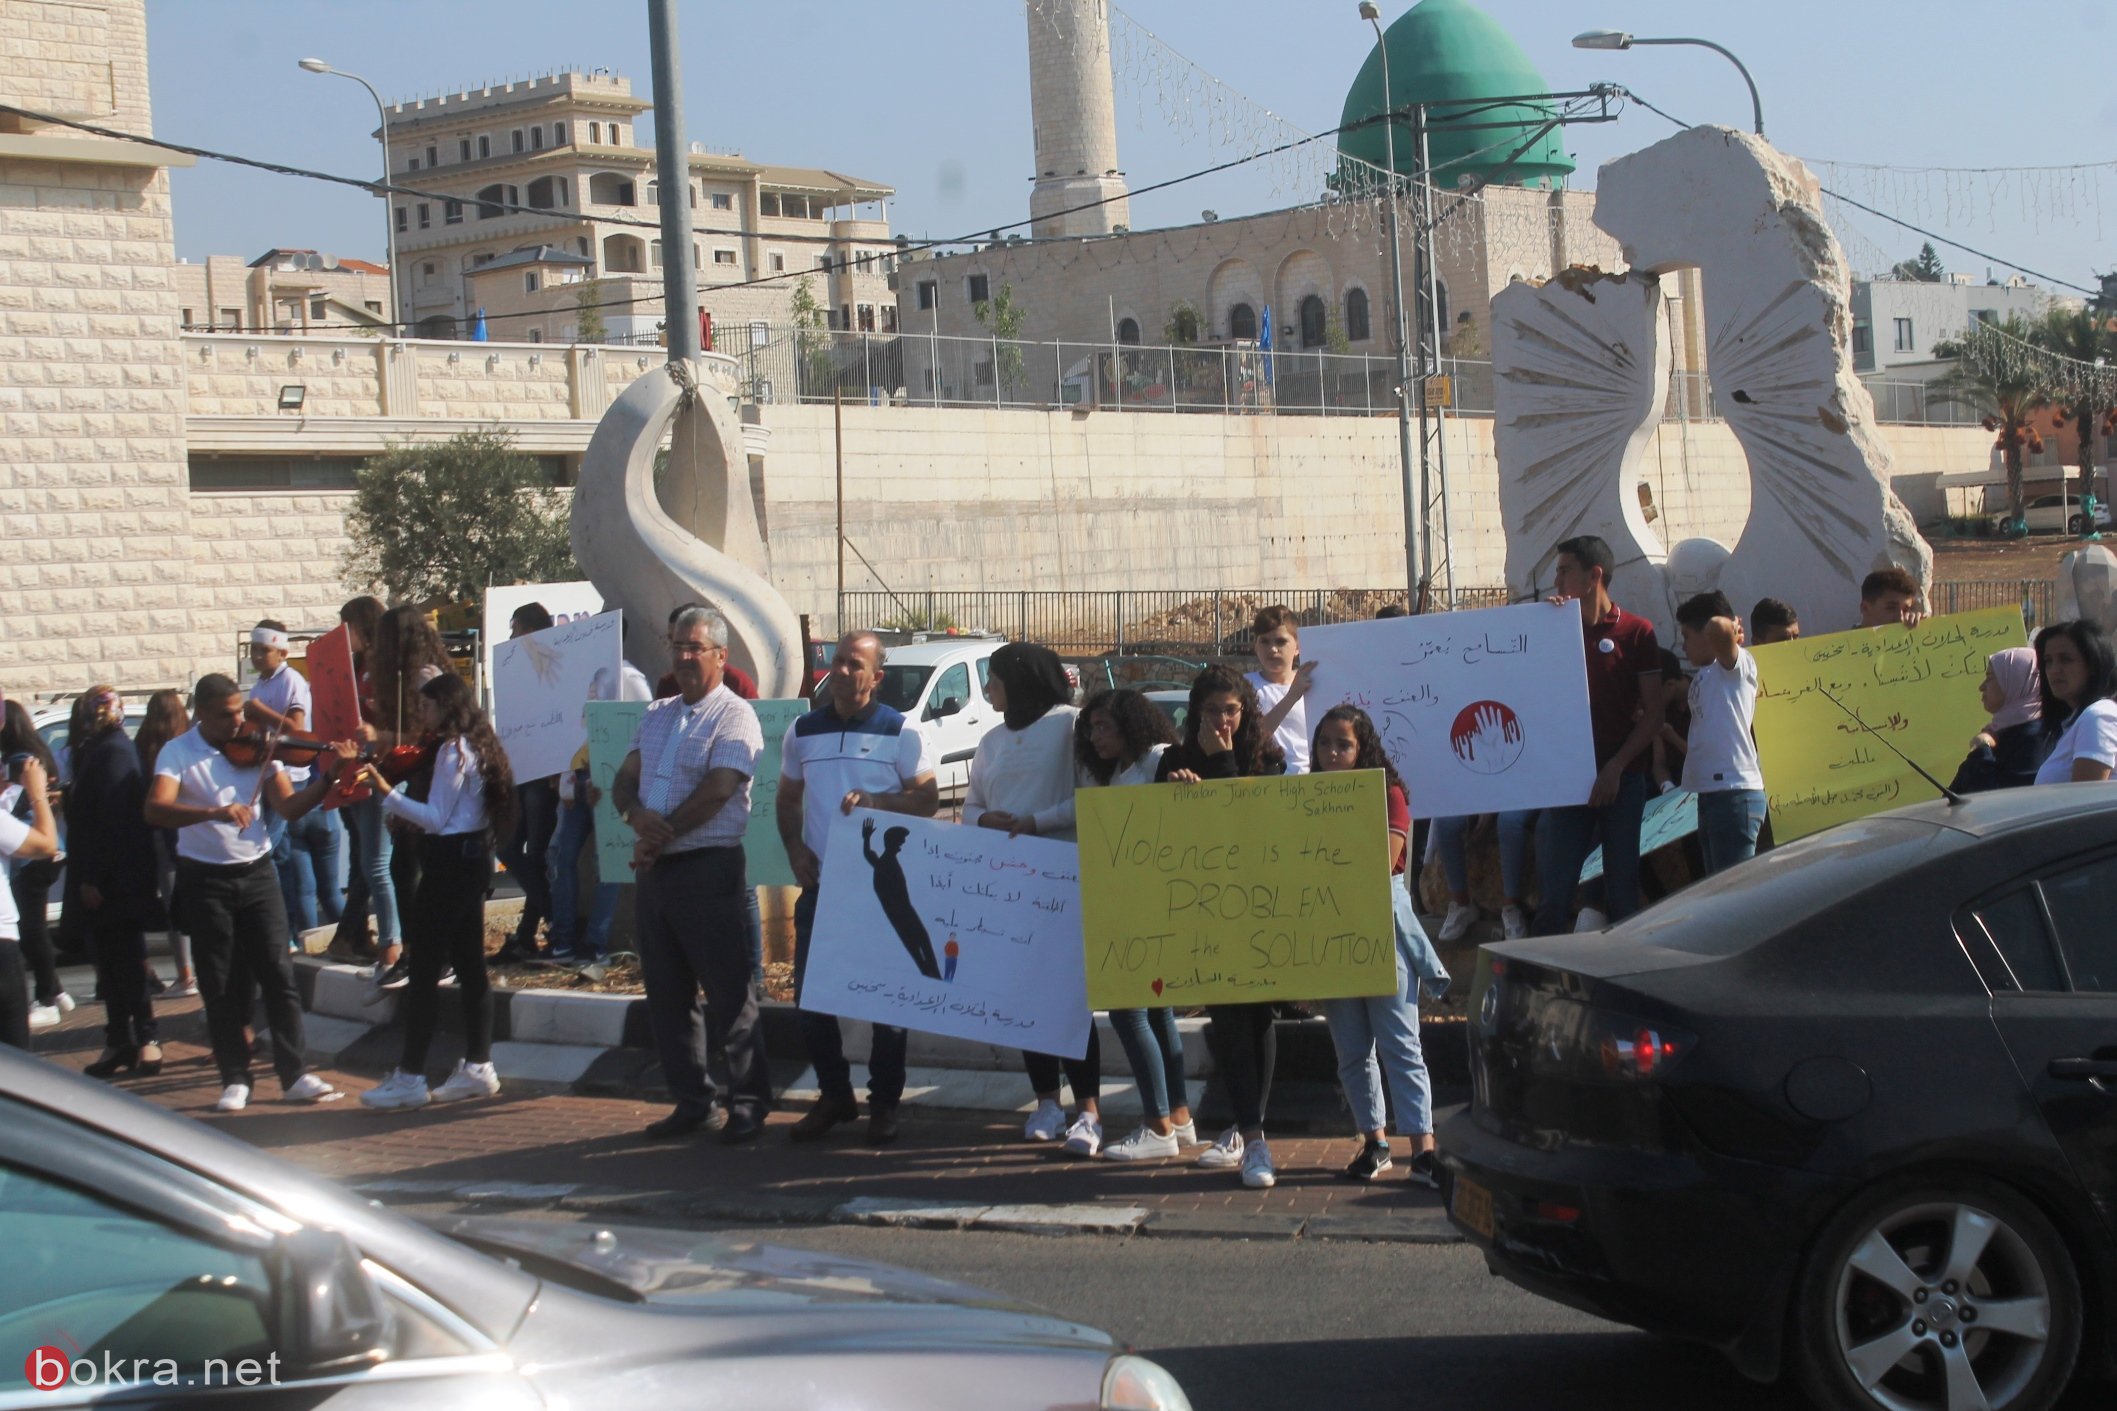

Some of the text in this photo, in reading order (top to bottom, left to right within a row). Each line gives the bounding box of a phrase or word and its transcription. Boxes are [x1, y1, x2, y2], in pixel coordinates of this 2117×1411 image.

[1223, 784, 1271, 808] Junior
[1279, 780, 1306, 809] High
[1302, 799, 1355, 817] Sakhnin
[1093, 801, 1352, 872] Violence is the
[1042, 869, 1079, 883] عنف
[1166, 878, 1341, 921] PROBLEM
[1101, 929, 1391, 972] NOT the SOLUTION
